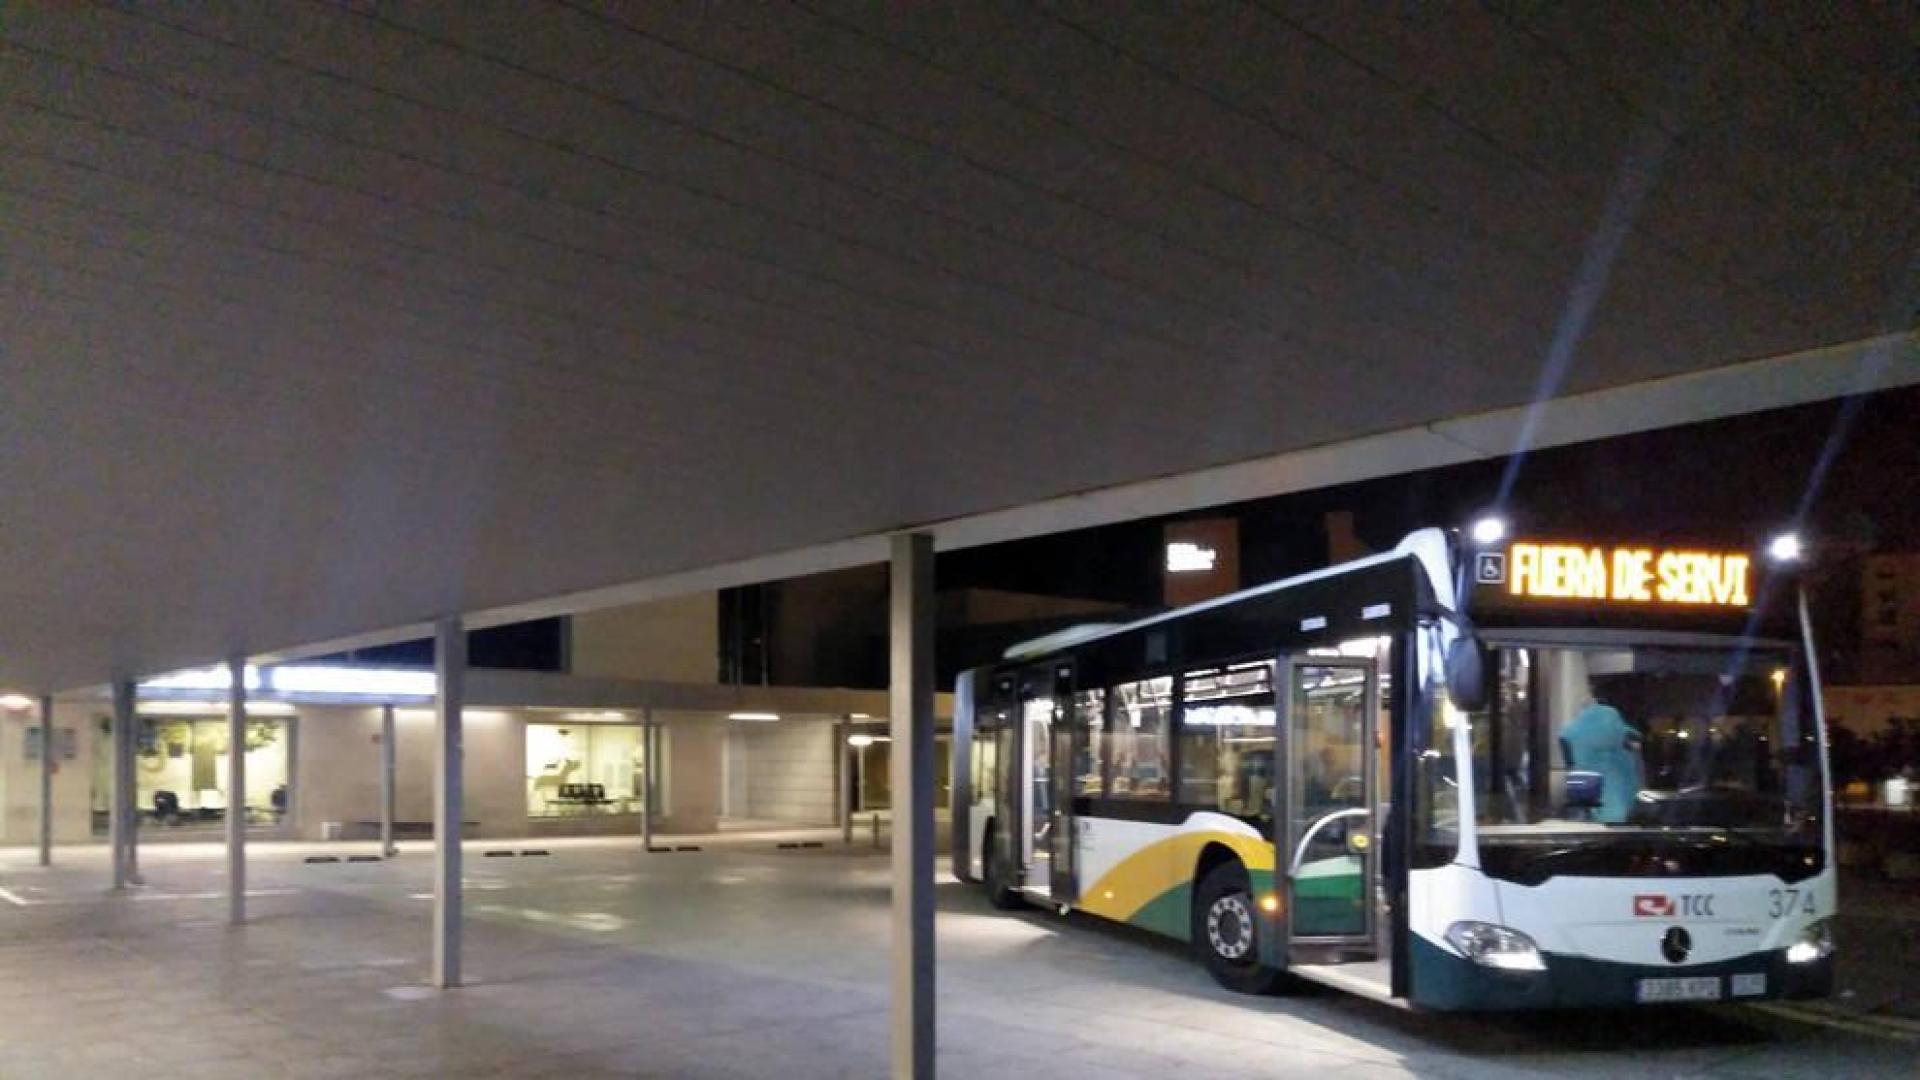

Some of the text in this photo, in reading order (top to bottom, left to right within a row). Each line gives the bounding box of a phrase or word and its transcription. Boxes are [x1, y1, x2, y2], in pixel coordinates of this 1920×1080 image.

[1510, 543, 1749, 606] FUERA DE SERVI
[1681, 894, 1714, 916] TCC
[1768, 889, 1816, 919] 374
